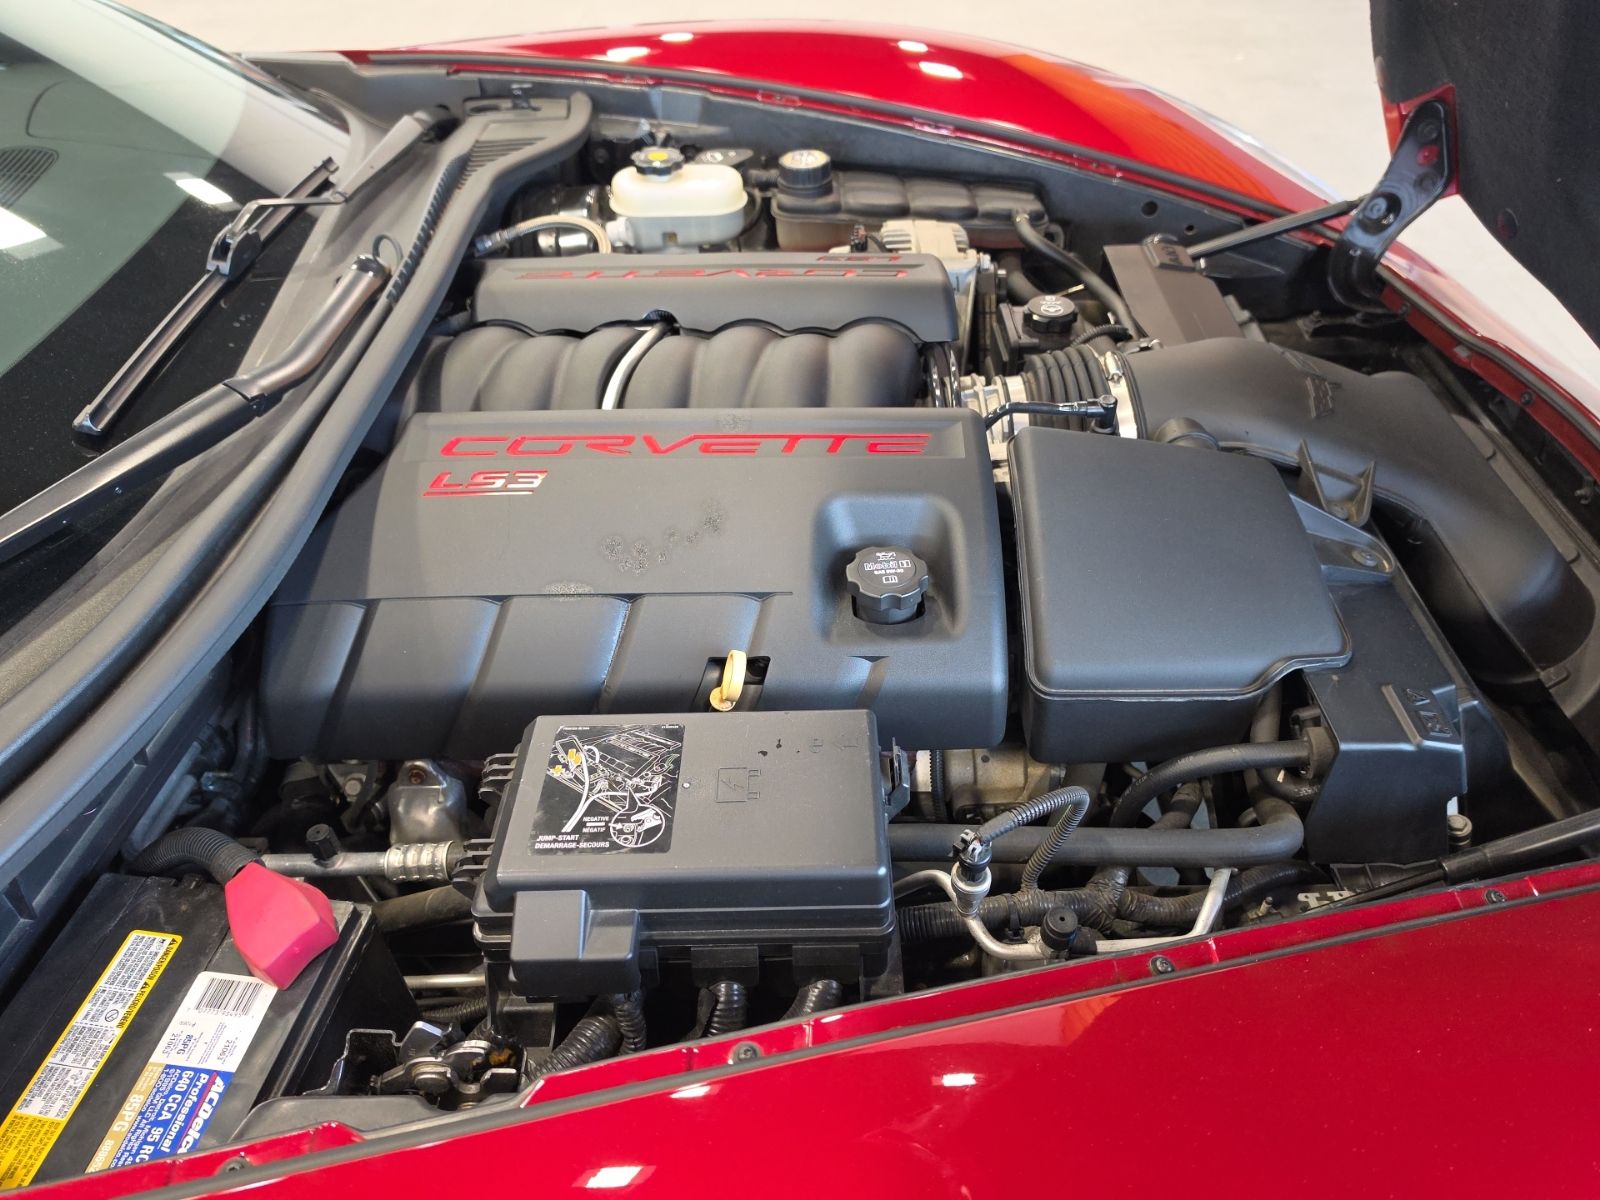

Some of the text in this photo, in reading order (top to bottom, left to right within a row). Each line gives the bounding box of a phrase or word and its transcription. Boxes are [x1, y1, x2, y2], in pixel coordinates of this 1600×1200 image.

[515, 268, 910, 281] CORVETTE
[440, 434, 930, 457] CORVETTE
[427, 469, 549, 489] LS3
[864, 560, 897, 570] Mobil
[536, 834, 579, 842] JUMP-START
[174, 1070, 194, 1092] 640
[112, 1093, 145, 1132] 85PG
[157, 1094, 182, 1121] CCA
[160, 1072, 209, 1153] Professional
[146, 1126, 164, 1143] 95
